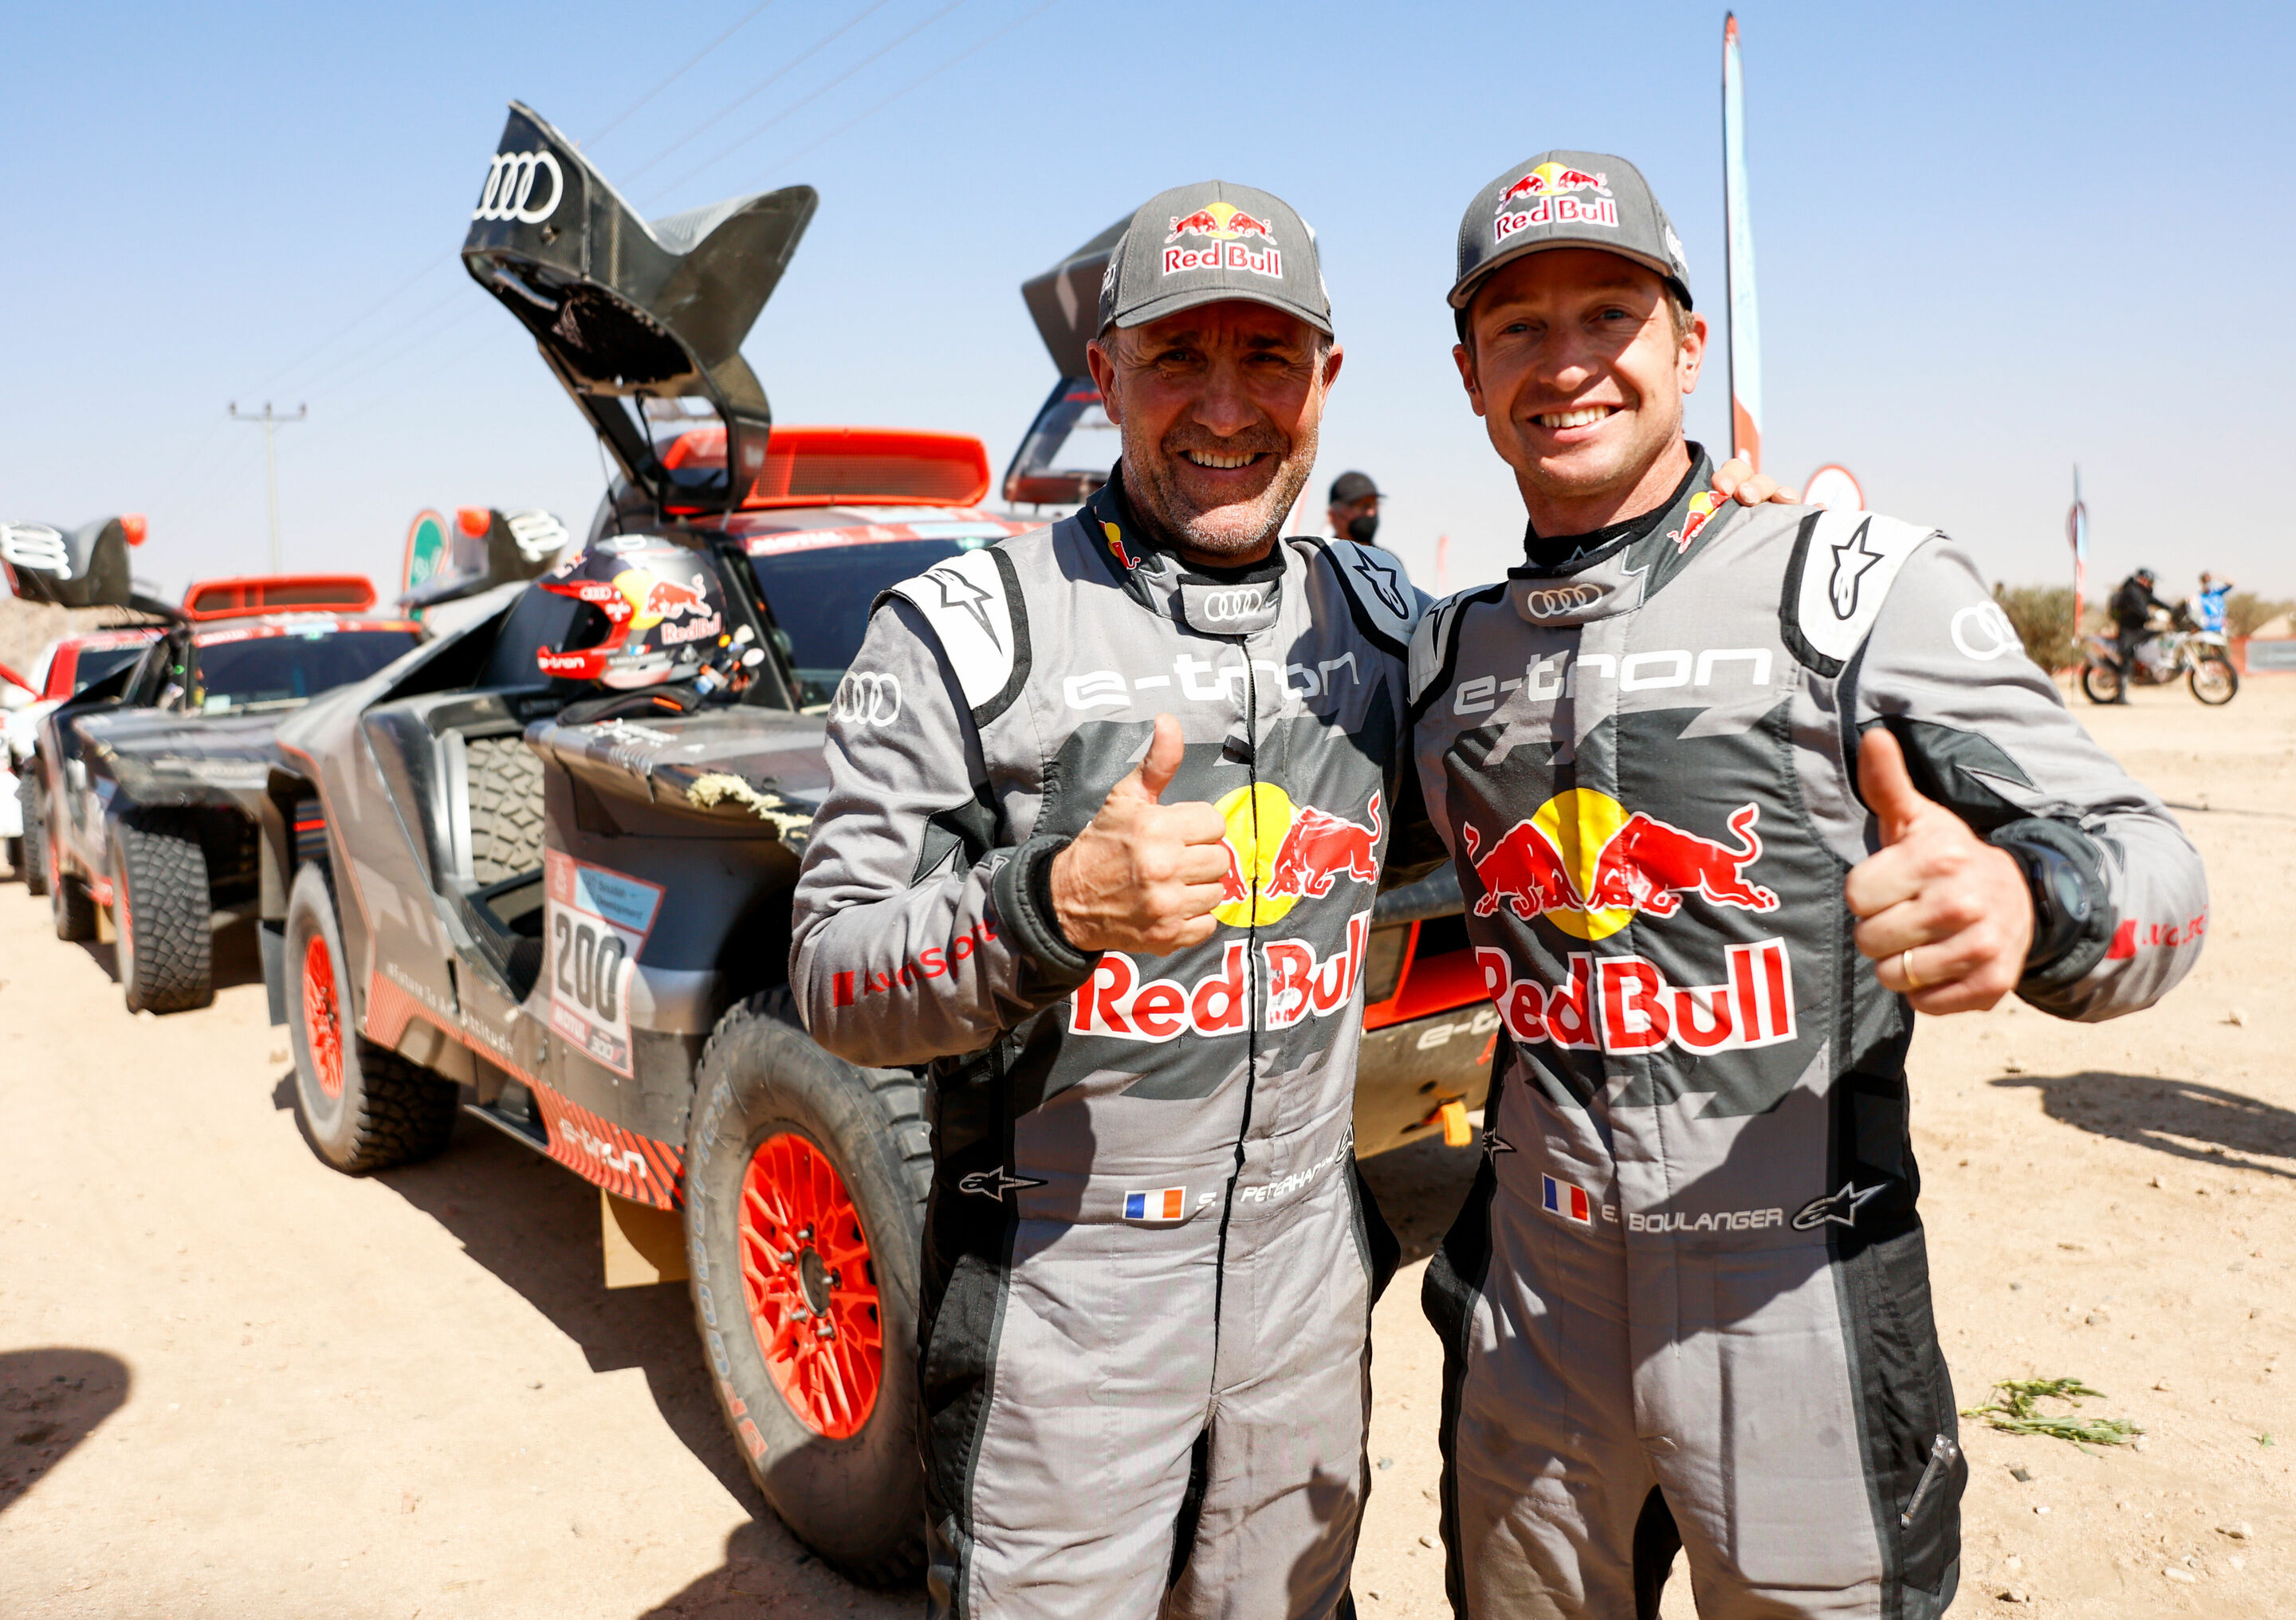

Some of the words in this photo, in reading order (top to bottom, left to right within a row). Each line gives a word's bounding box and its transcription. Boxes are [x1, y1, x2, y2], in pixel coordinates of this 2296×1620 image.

[1492, 194, 1553, 245] Red
[1554, 196, 1619, 227] Bull
[1162, 239, 1222, 277] Red
[1225, 242, 1283, 279] Bull
[1453, 648, 1772, 715] e-tron
[555, 912, 627, 1023] 200
[1067, 938, 1250, 1044] Red
[1595, 936, 1798, 1056] Bull
[1601, 1205, 1618, 1224] E.
[1629, 1207, 1783, 1233] BOULANGER
